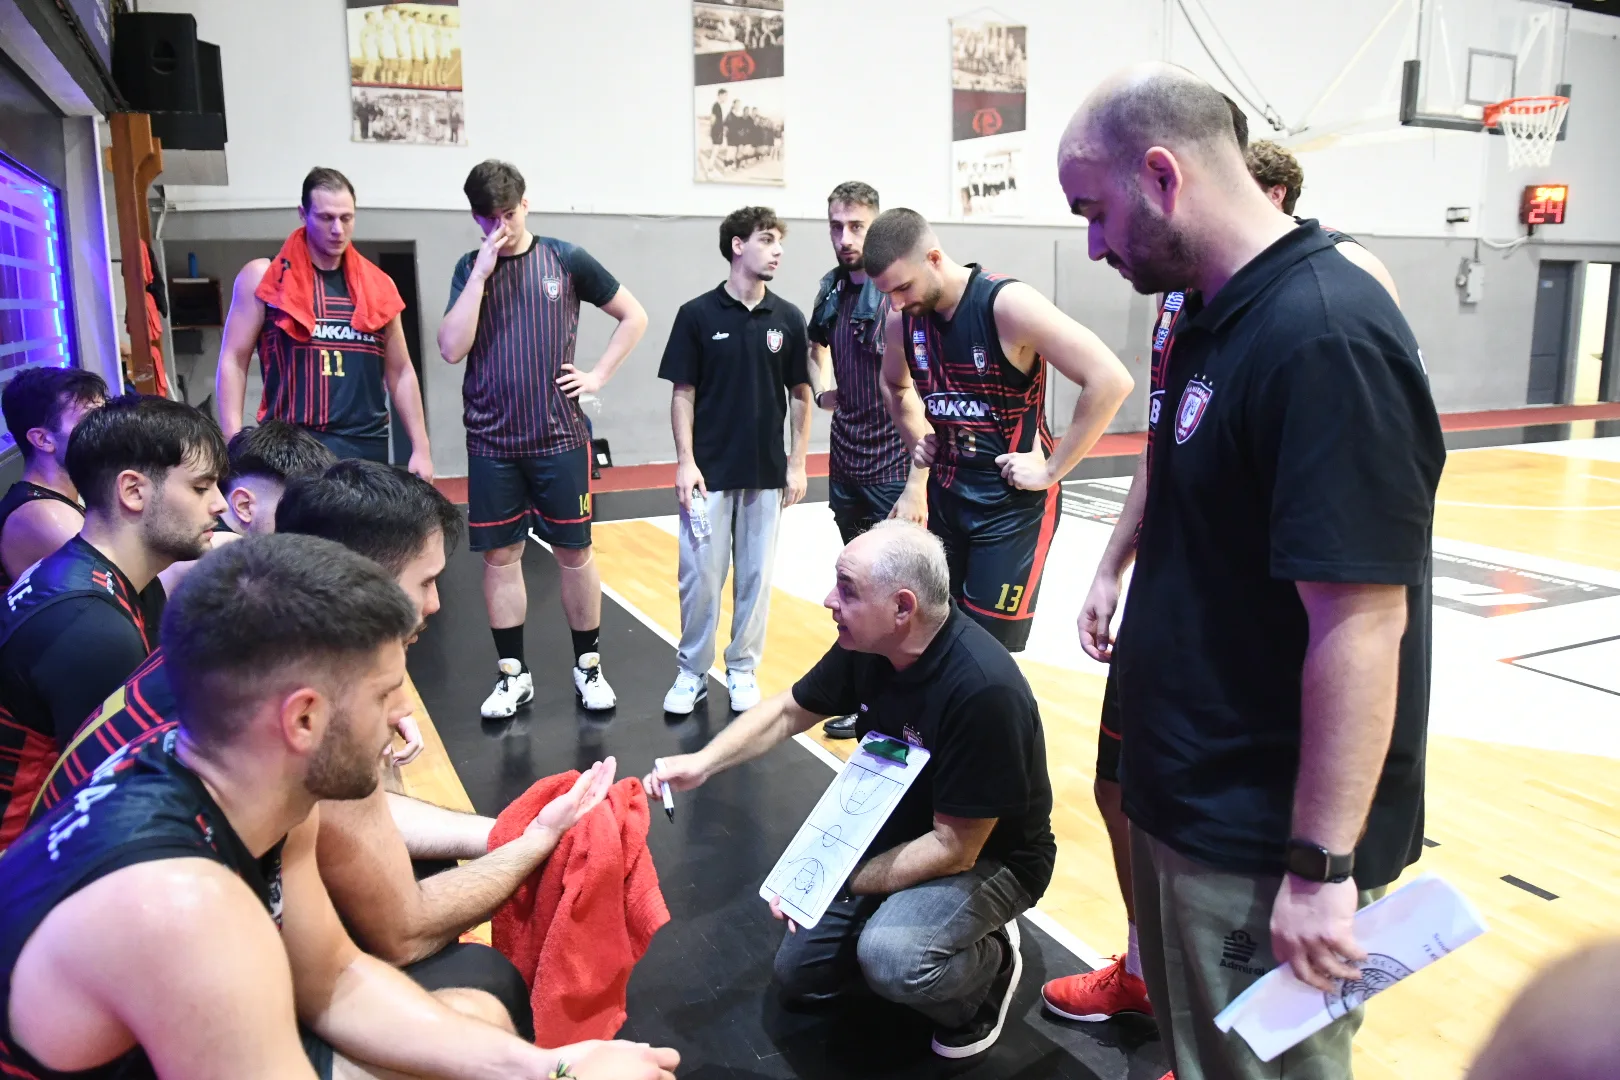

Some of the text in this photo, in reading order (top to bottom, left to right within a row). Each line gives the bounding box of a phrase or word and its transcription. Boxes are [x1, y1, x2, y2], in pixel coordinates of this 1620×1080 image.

[1528, 199, 1563, 223] 24
[321, 350, 345, 377] 11
[579, 493, 590, 516] 14
[995, 583, 1024, 612] 13
